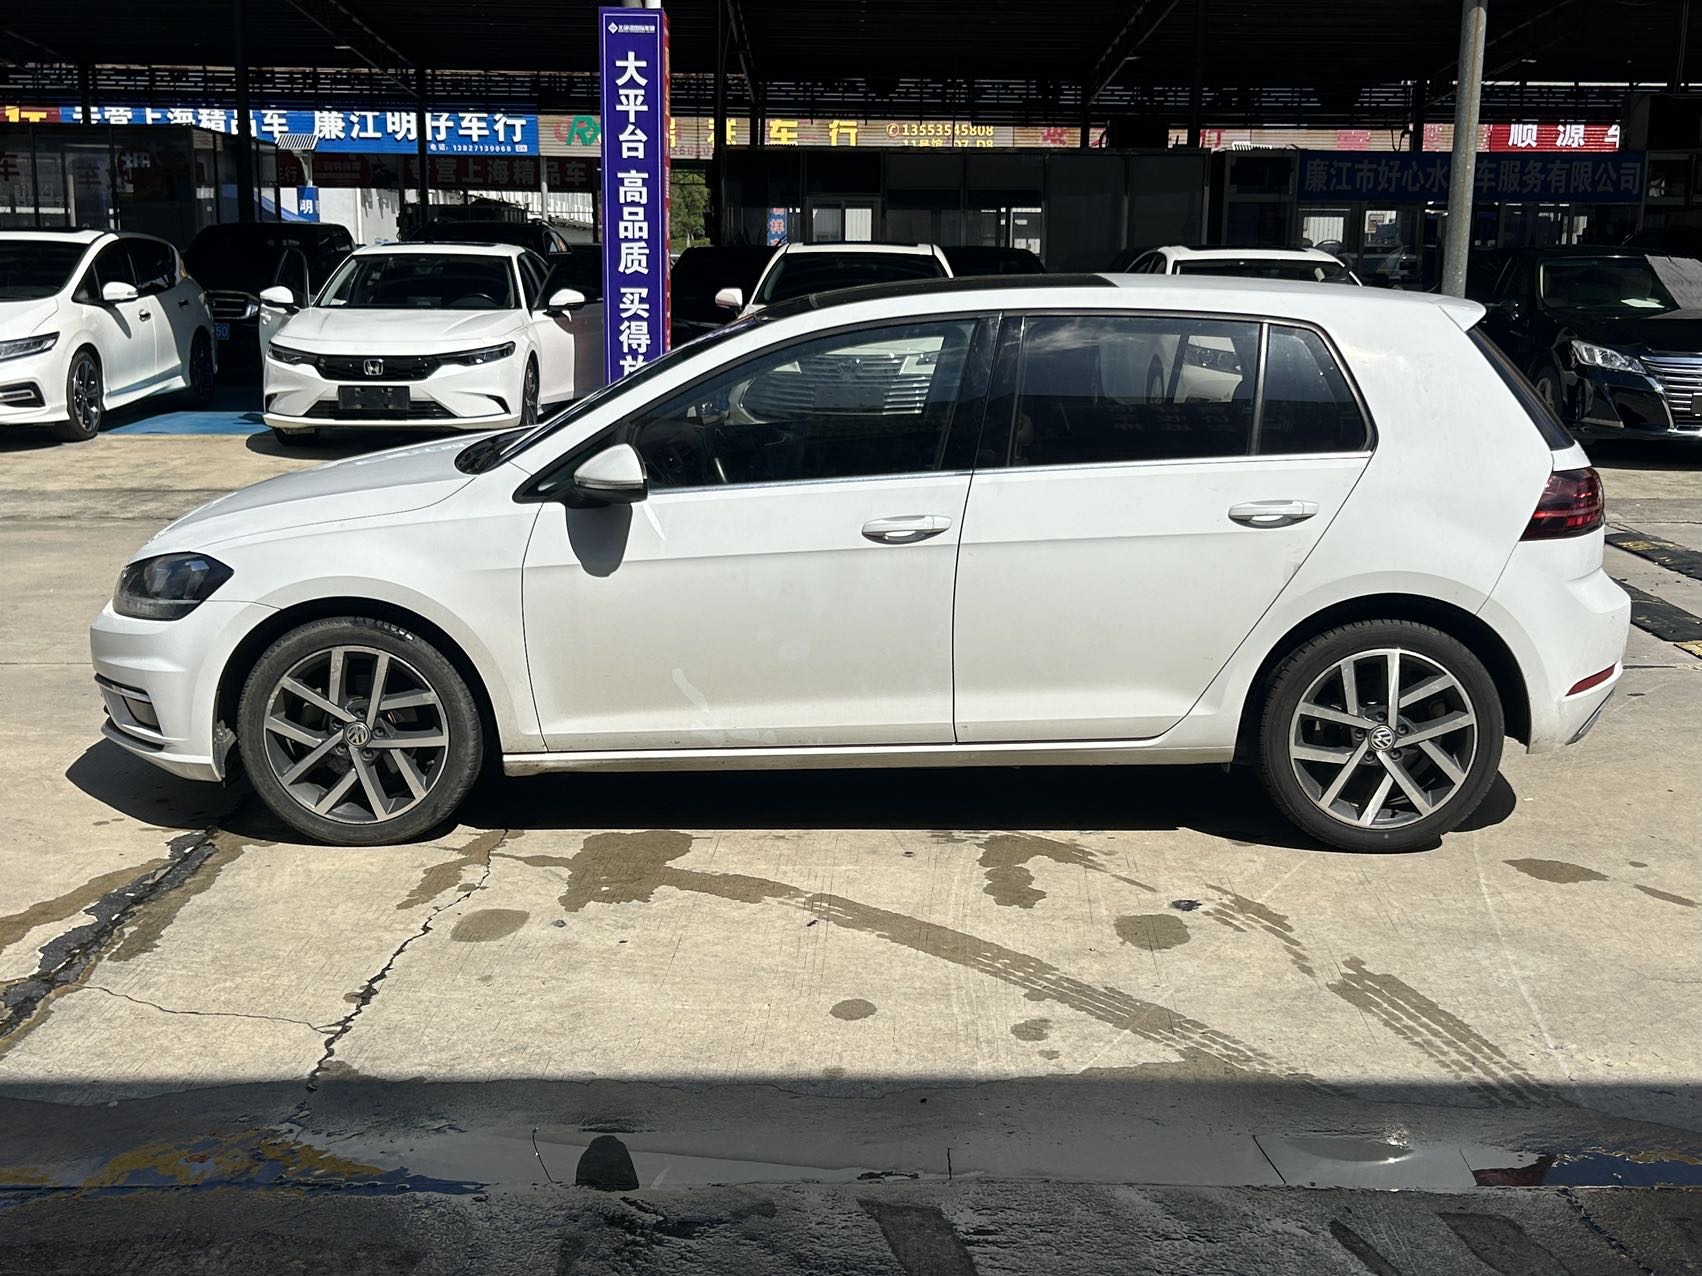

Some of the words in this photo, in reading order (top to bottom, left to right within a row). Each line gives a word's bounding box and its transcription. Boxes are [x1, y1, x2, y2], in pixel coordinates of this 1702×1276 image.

[615, 51, 649, 159] 大平台
[314, 110, 526, 143] 廉江明仔车行
[902, 124, 994, 137] 13553545808
[453, 144, 511, 153] 13827139068
[1304, 158, 1642, 195] 廉江市好心水车服务有限公司
[299, 199, 320, 214] 明
[617, 170, 650, 275] 高品质
